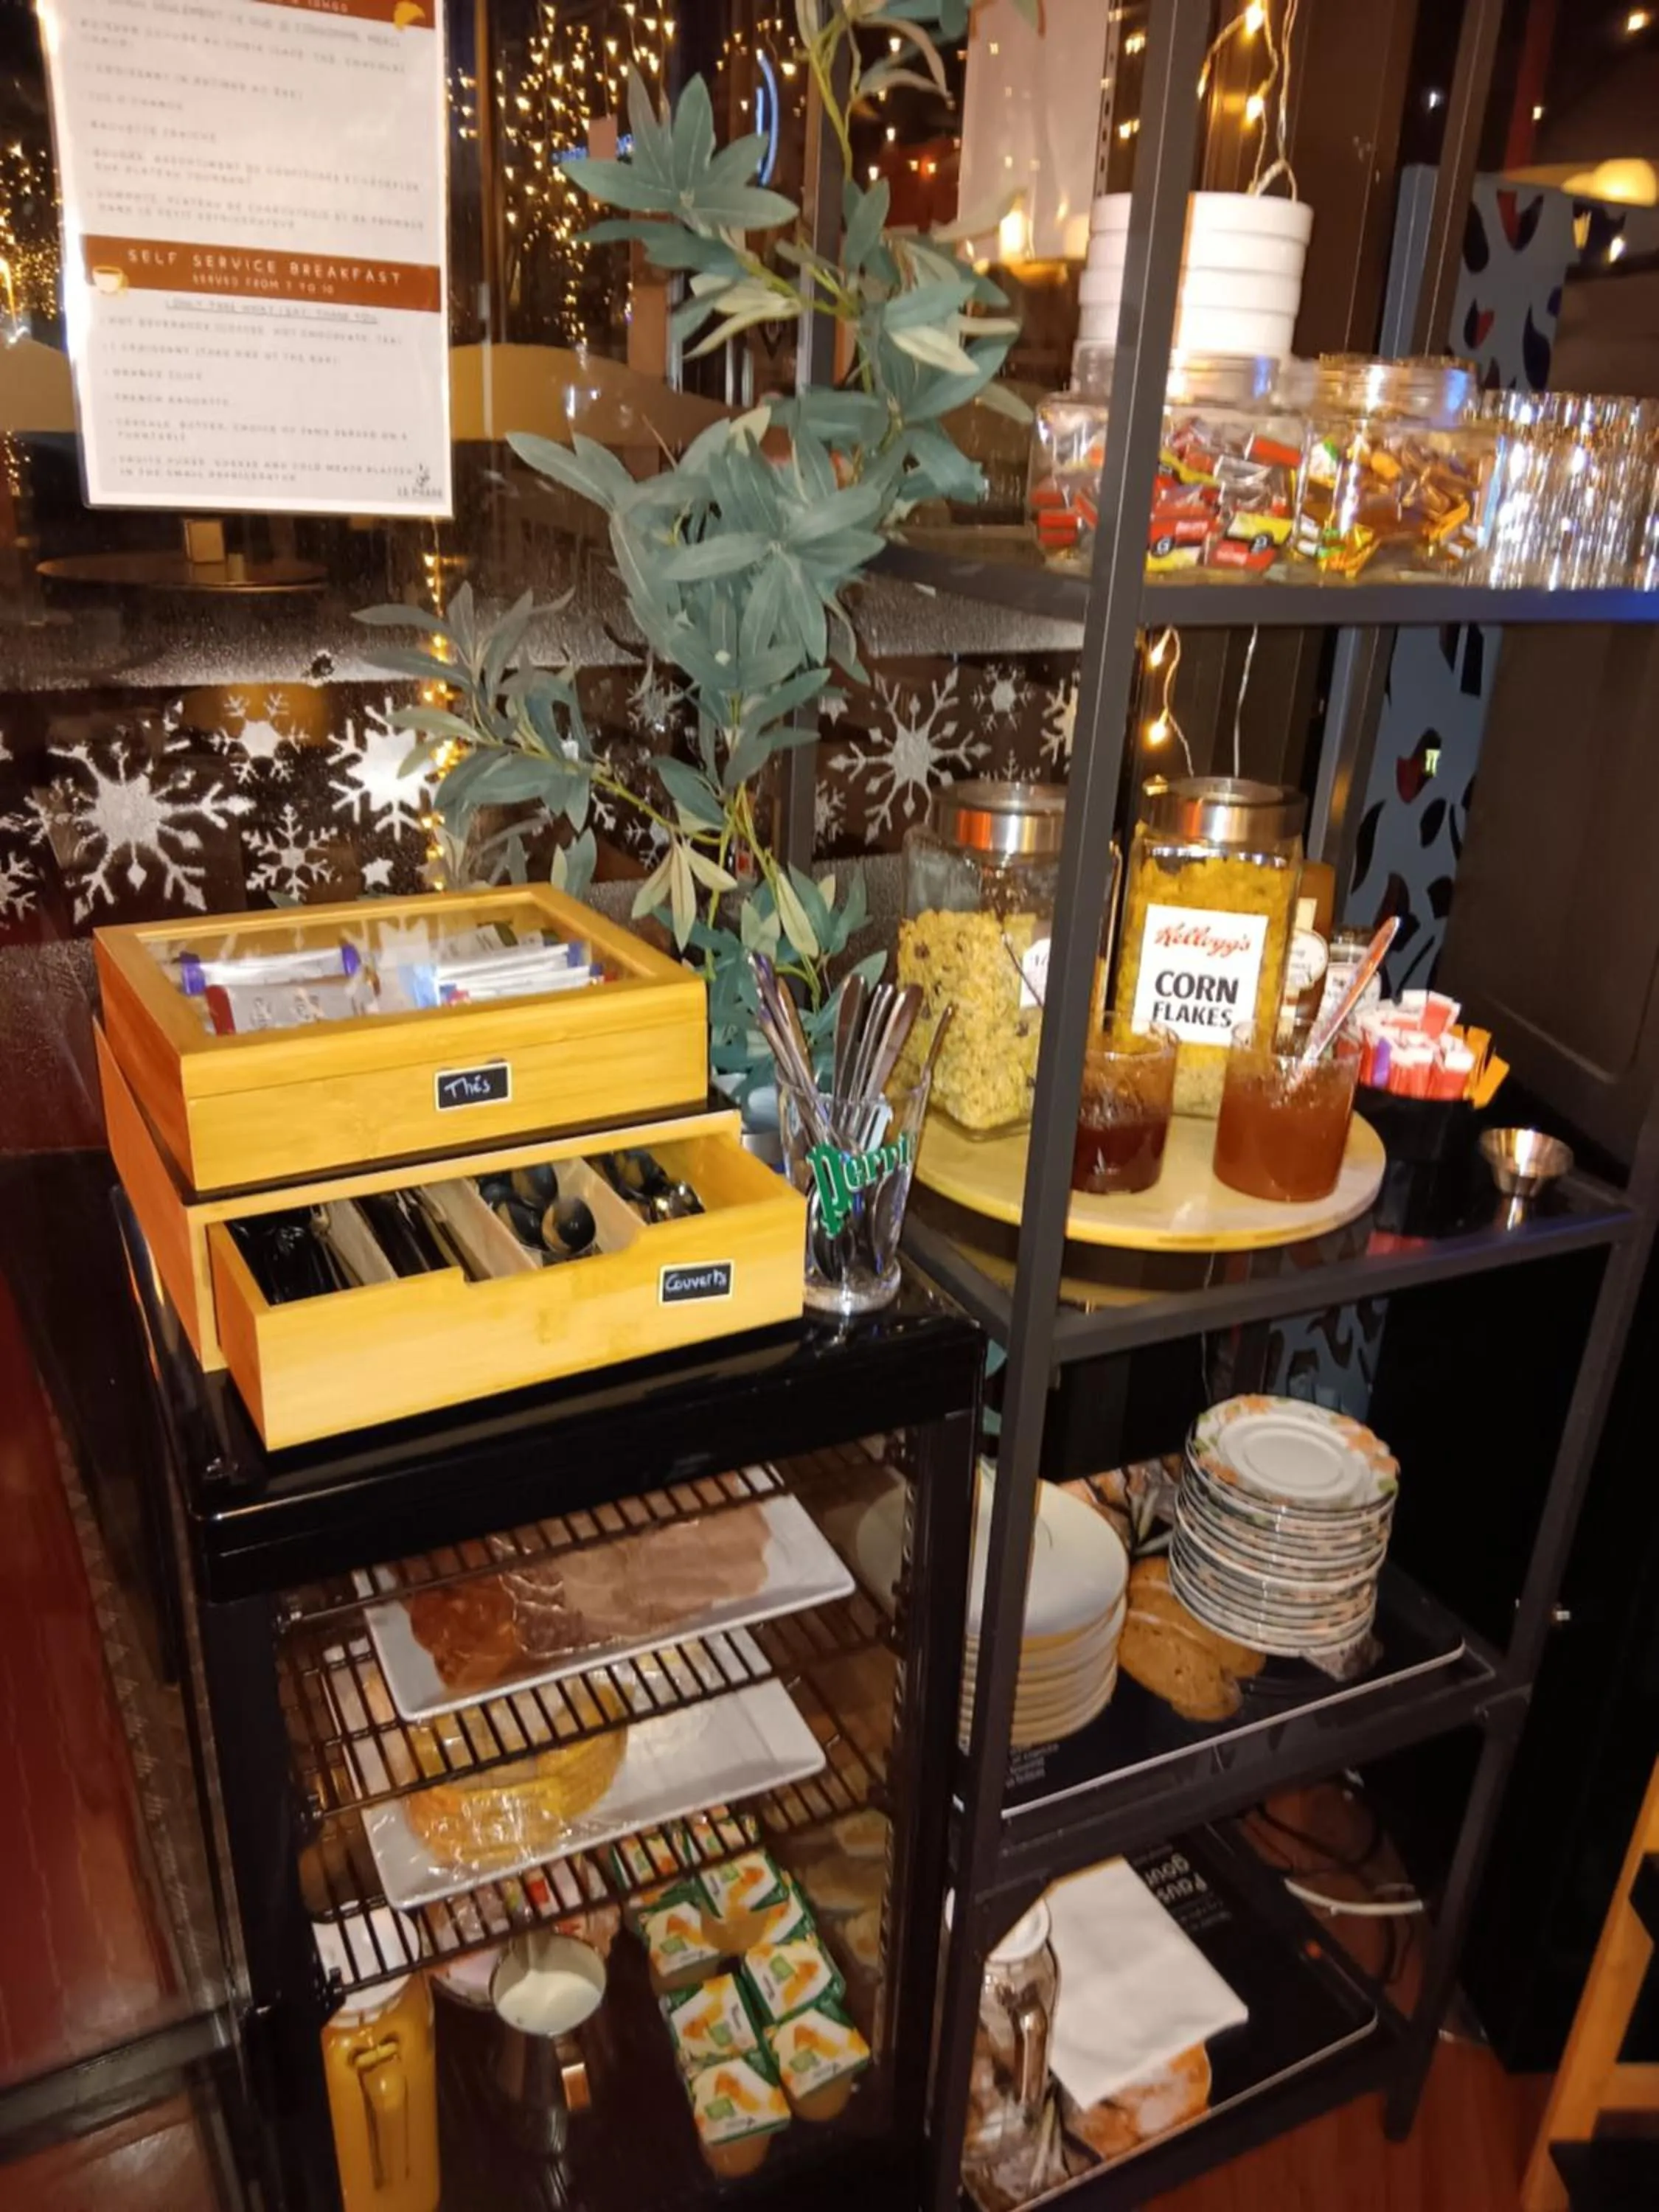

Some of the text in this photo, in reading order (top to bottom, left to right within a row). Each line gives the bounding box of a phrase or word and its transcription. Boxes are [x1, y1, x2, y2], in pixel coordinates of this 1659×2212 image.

[128, 248, 400, 286] SELF SERVICE BREAKFAST
[246, 276, 279, 291] FROM
[299, 282, 316, 293] TO
[1155, 922, 1251, 957] Kellogg's
[1155, 970, 1239, 1004] CORN
[1152, 1001, 1233, 1028] FLAKES
[806, 1133, 914, 1239] Perri
